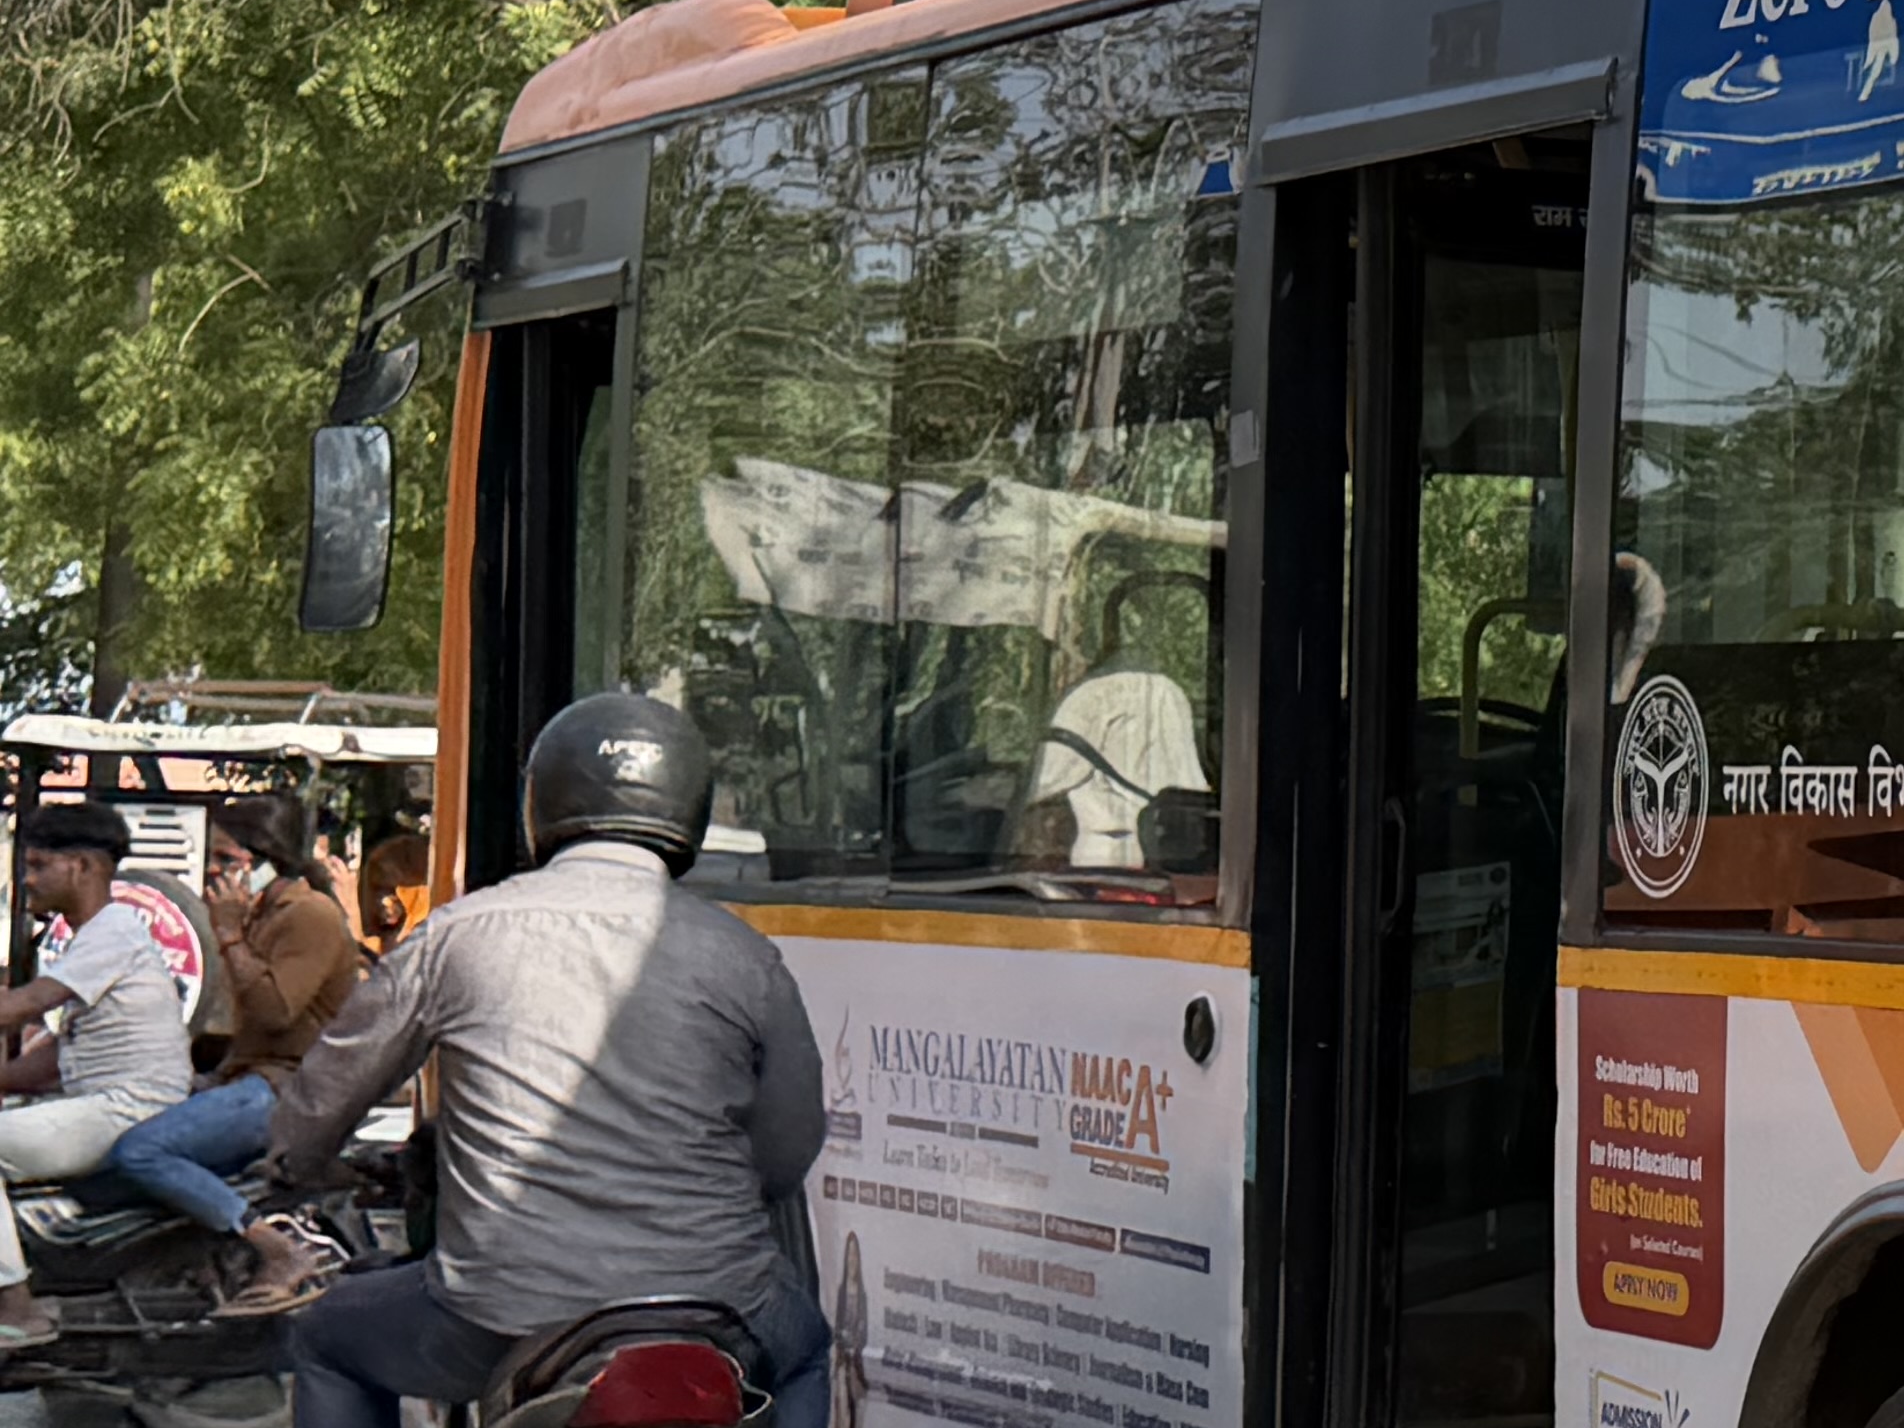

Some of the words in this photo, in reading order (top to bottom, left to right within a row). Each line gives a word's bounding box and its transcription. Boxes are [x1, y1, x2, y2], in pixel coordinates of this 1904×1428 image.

[1722, 764, 1771, 815] नगर
[1780, 744, 1858, 817] विकास
[868, 1024, 1068, 1096] MANGALAYATAN
[1070, 1051, 1133, 1107] NAAC
[1595, 1054, 1662, 1092] Scholarship
[1663, 1065, 1699, 1095] Worth
[866, 1072, 1069, 1132] UNIVERSITY
[1603, 1093, 1626, 1130] Rs.
[1628, 1096, 1639, 1133] 5
[1069, 1104, 1127, 1149] GRADE
[1606, 1142, 1632, 1172] Free
[1590, 1176, 1626, 1216] Girls
